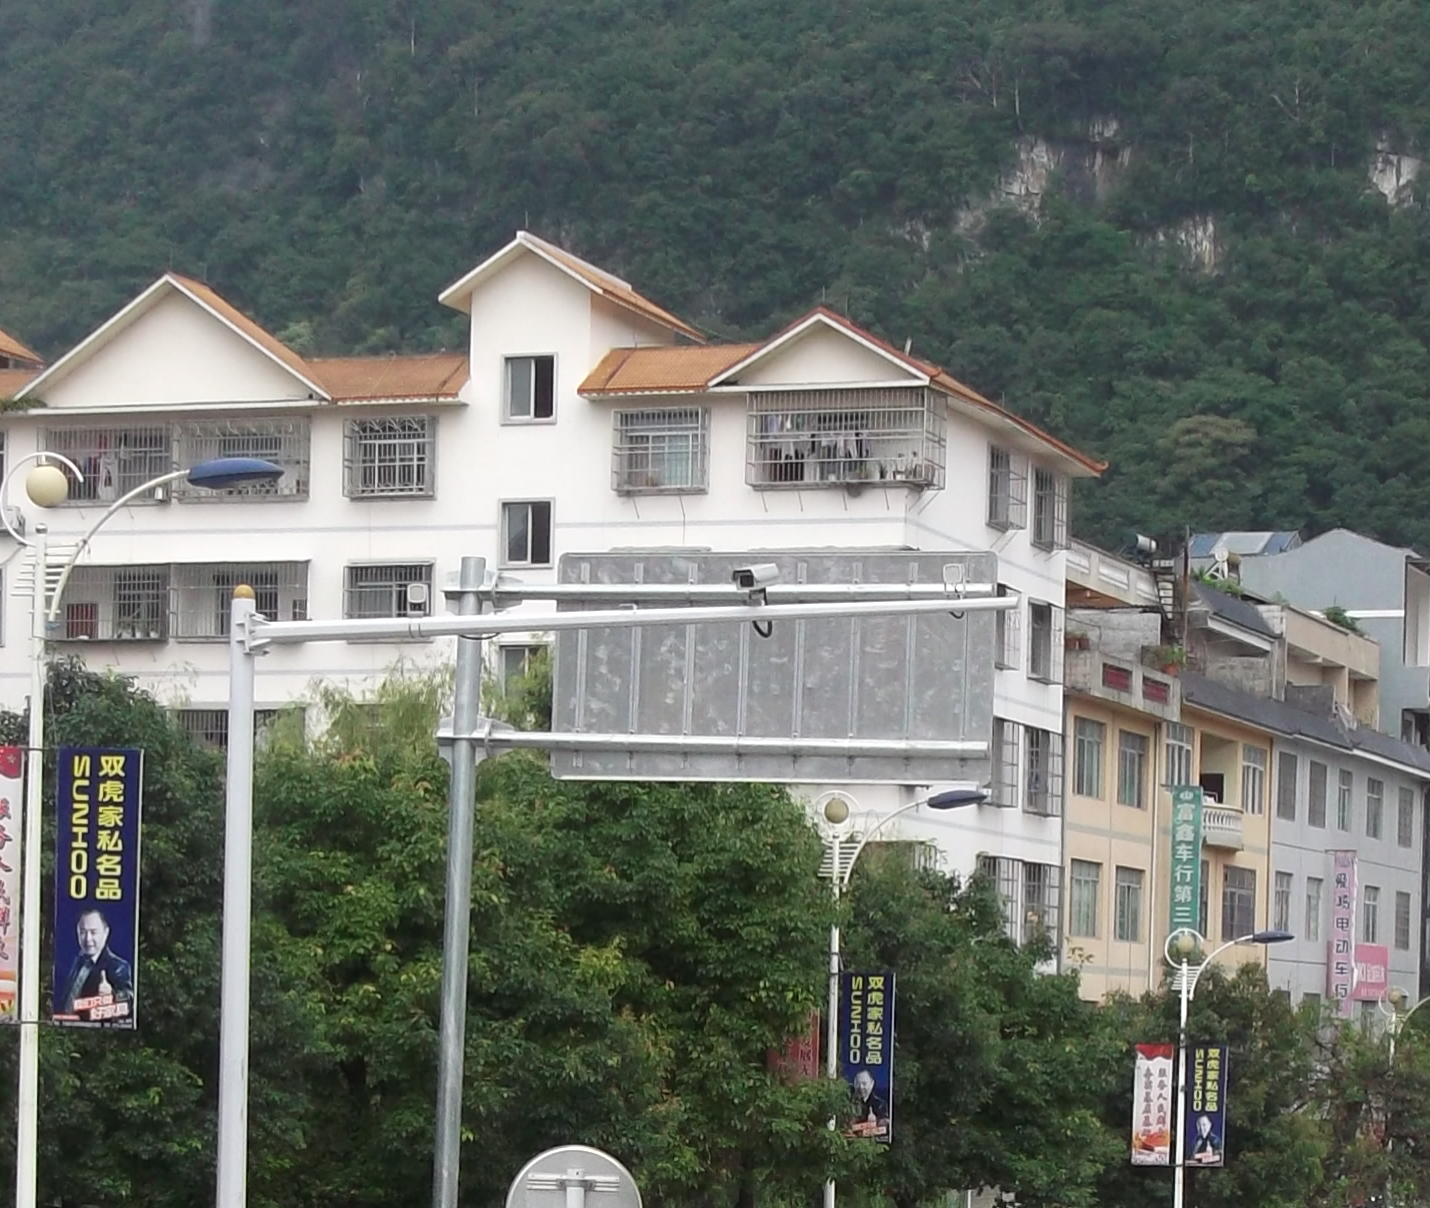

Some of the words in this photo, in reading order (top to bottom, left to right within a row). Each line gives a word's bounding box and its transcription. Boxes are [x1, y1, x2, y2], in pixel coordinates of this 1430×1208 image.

[69, 755, 90, 899] SUNHOO
[95, 755, 125, 900] 双虎家私名品
[1173, 803, 1196, 940] 富鑫车行第三
[865, 976, 884, 1065] 双虎家私名品
